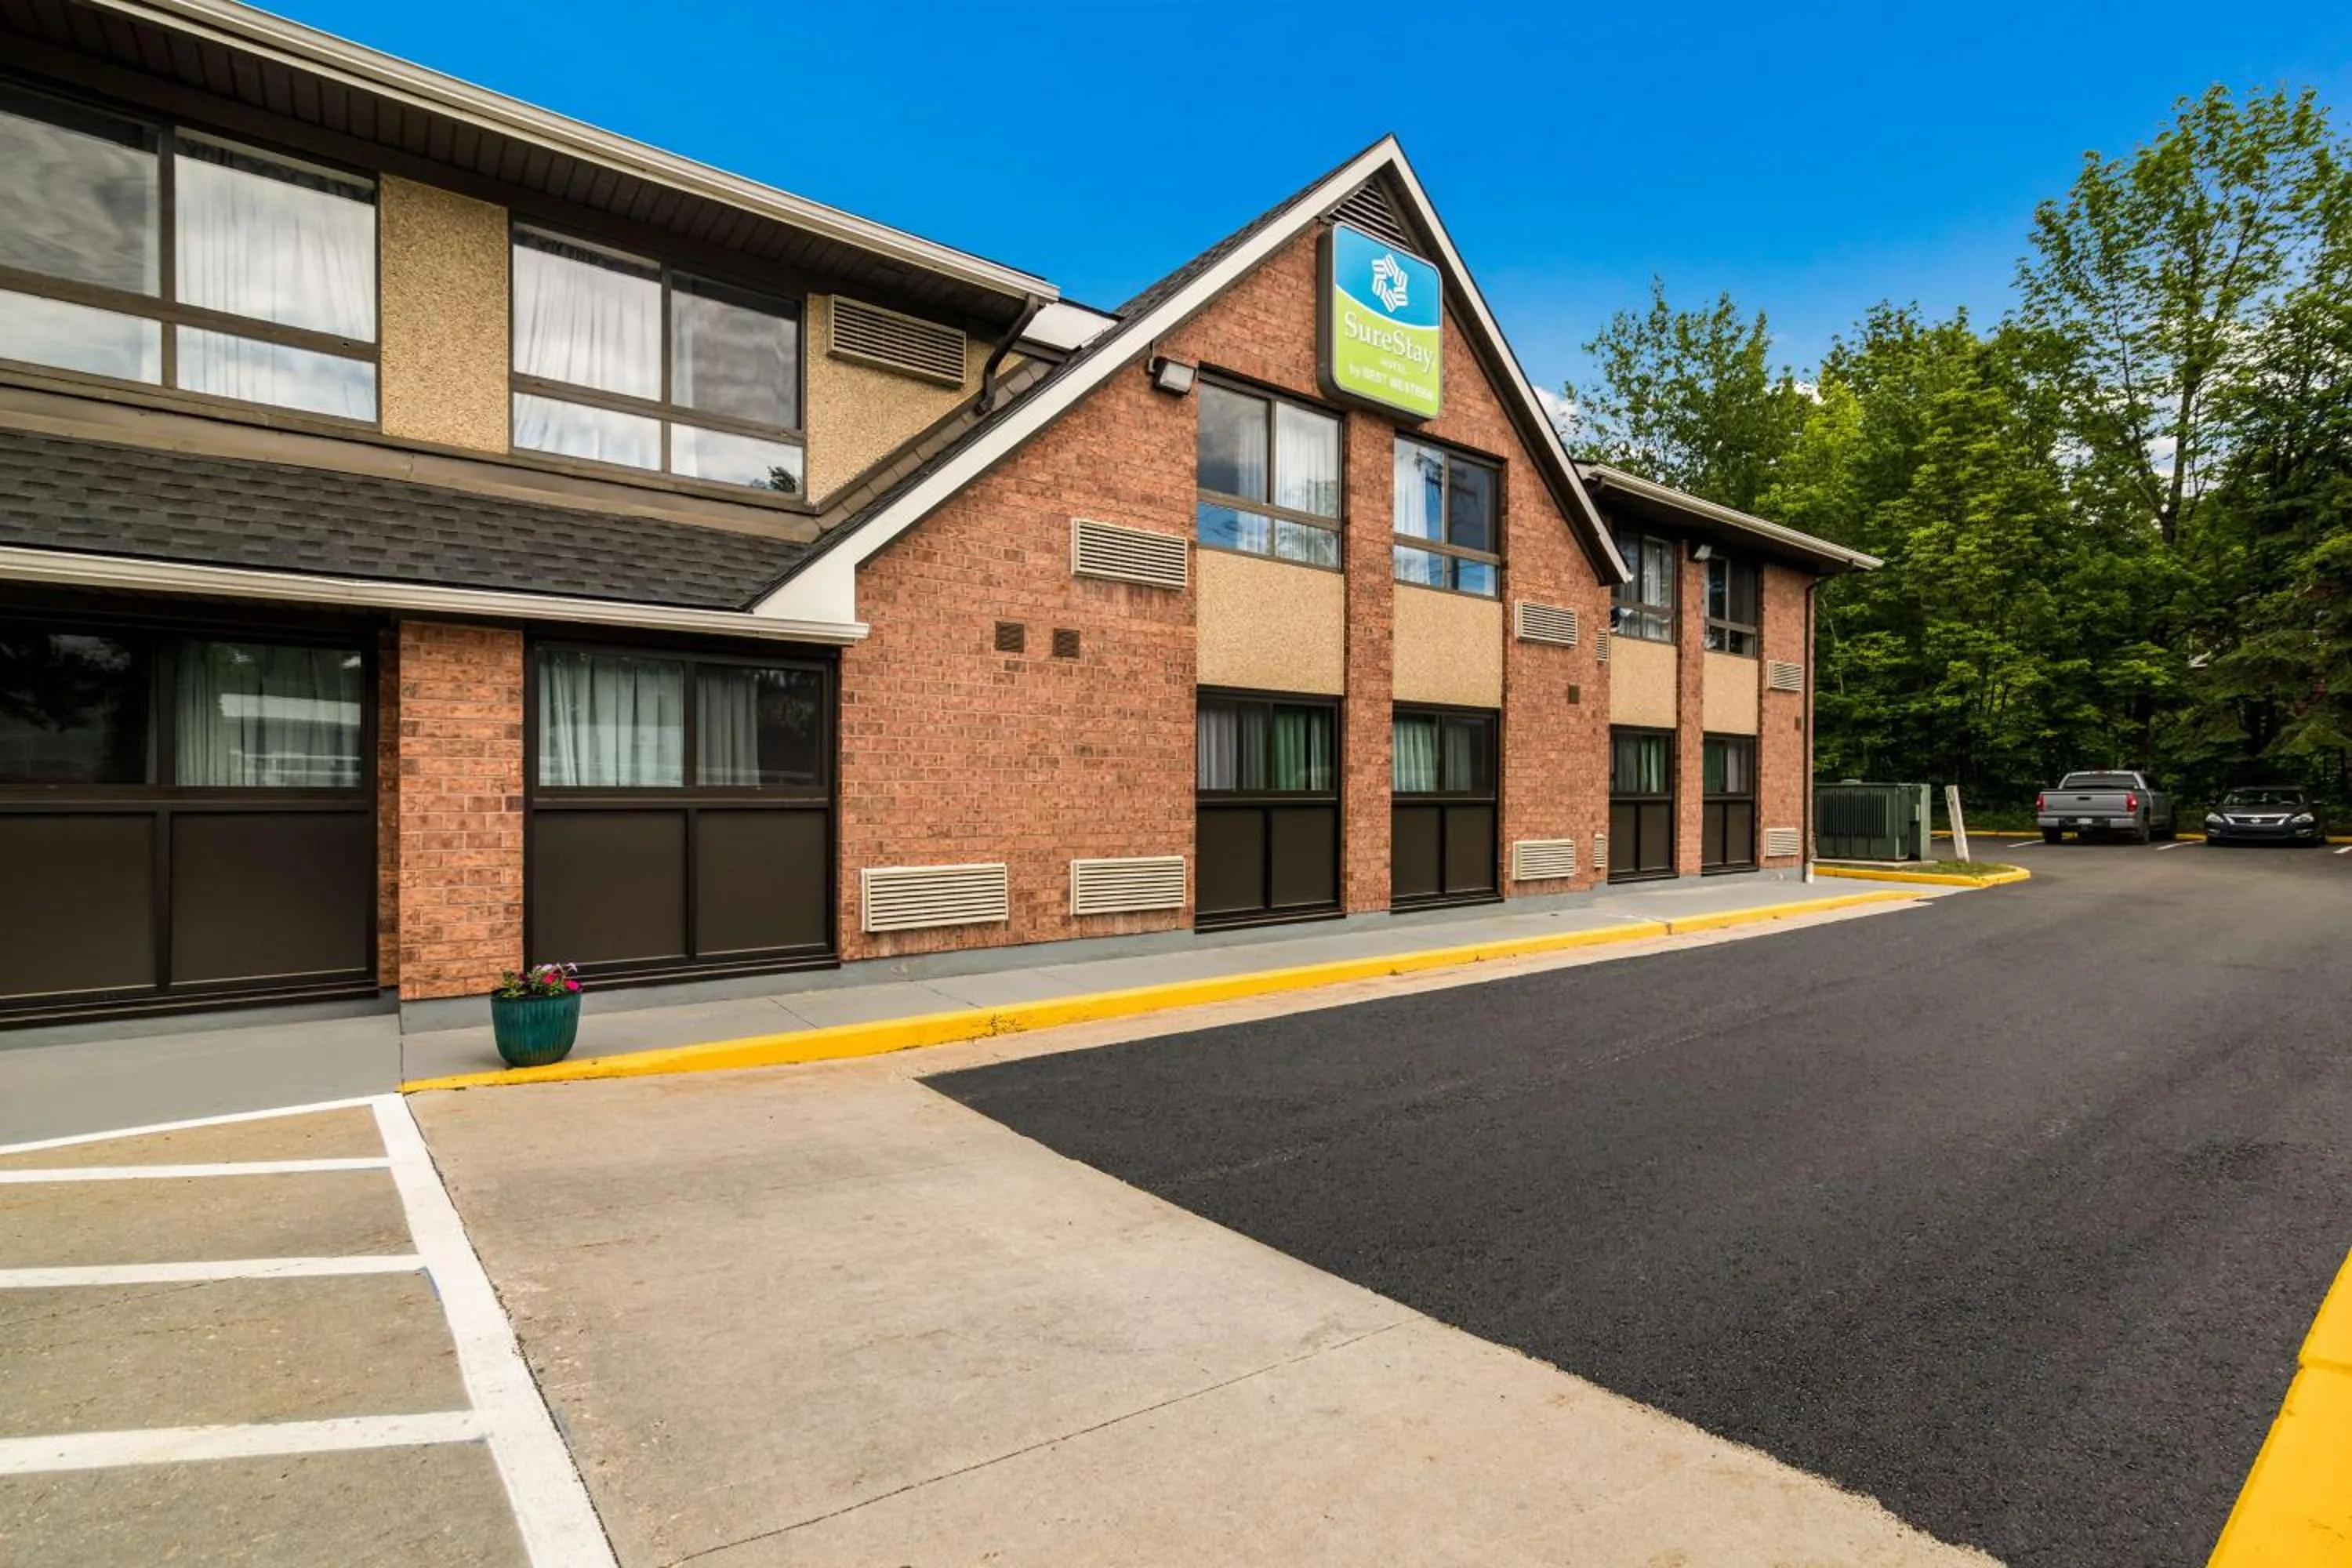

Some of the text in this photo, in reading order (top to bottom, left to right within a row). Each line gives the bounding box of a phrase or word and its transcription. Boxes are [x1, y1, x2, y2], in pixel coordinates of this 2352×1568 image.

[1344, 312, 1434, 372] SureStay
[1349, 363, 1360, 378] by
[1362, 366, 1388, 384] BEST
